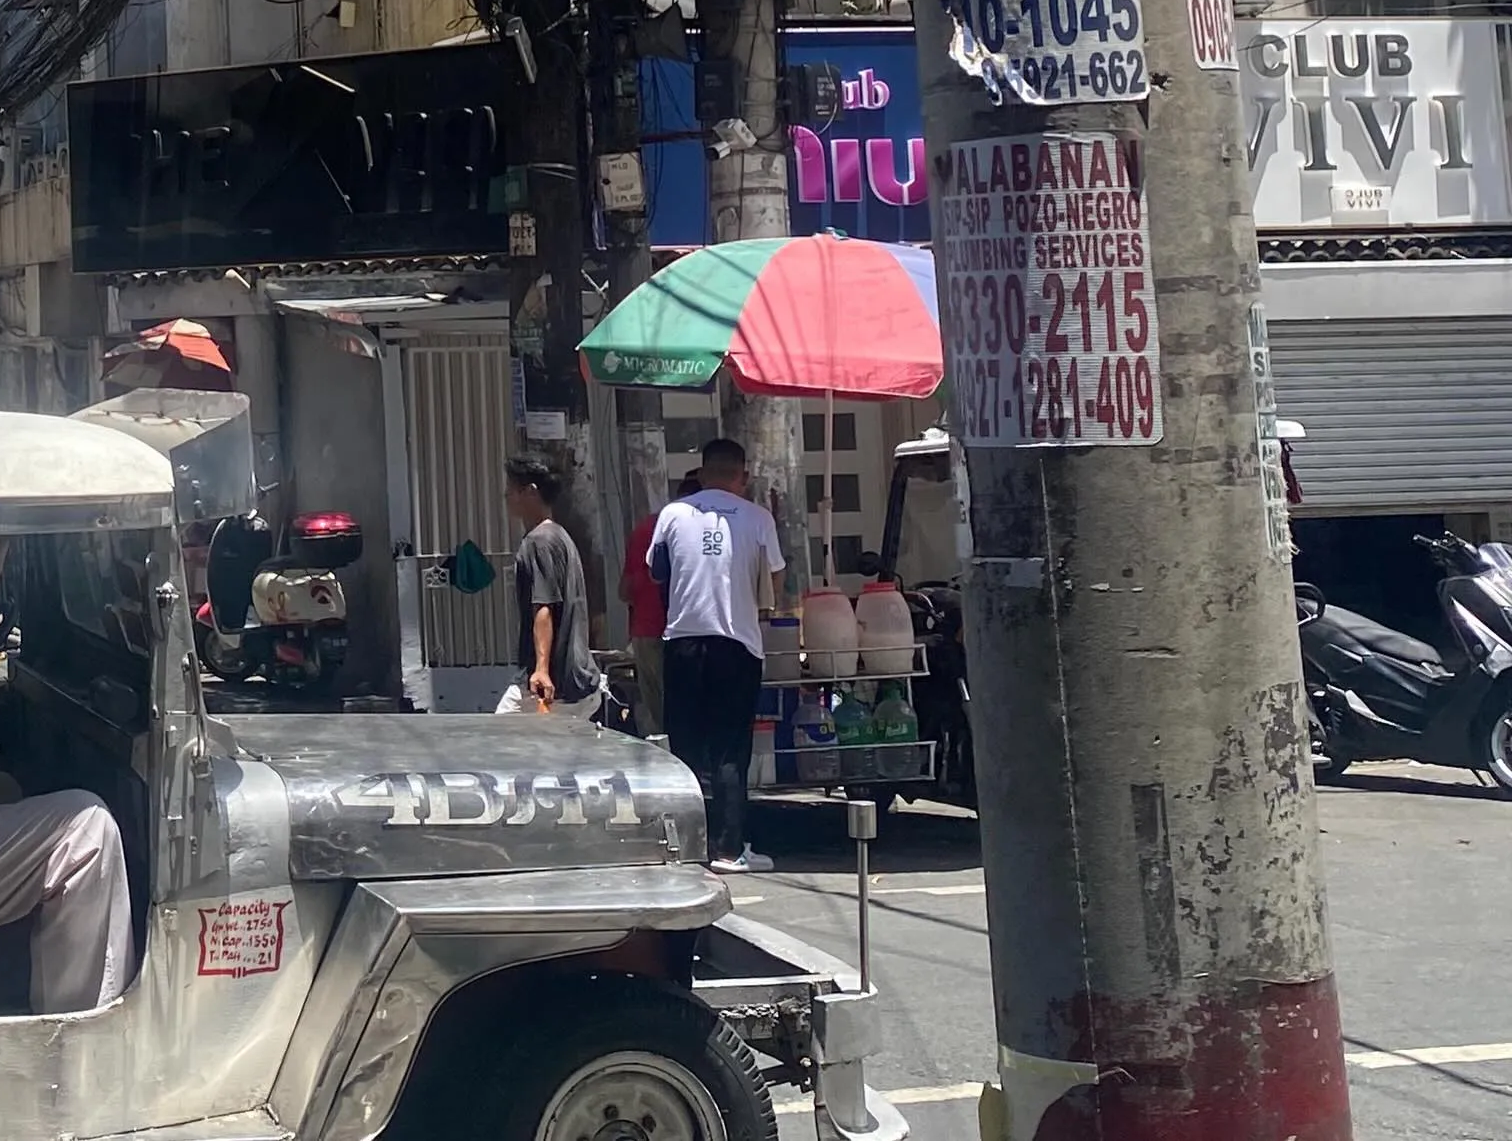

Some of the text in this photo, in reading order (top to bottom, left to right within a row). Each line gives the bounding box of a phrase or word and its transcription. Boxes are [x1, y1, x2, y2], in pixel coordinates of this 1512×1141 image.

[1249, 34, 1413, 77] CLUB
[1004, 191, 1141, 233] POZO-NEGRO
[1035, 233, 1144, 268] SERVICES
[702, 530, 724, 543] 20
[702, 543, 722, 555] 25
[218, 899, 270, 917] Capacity
